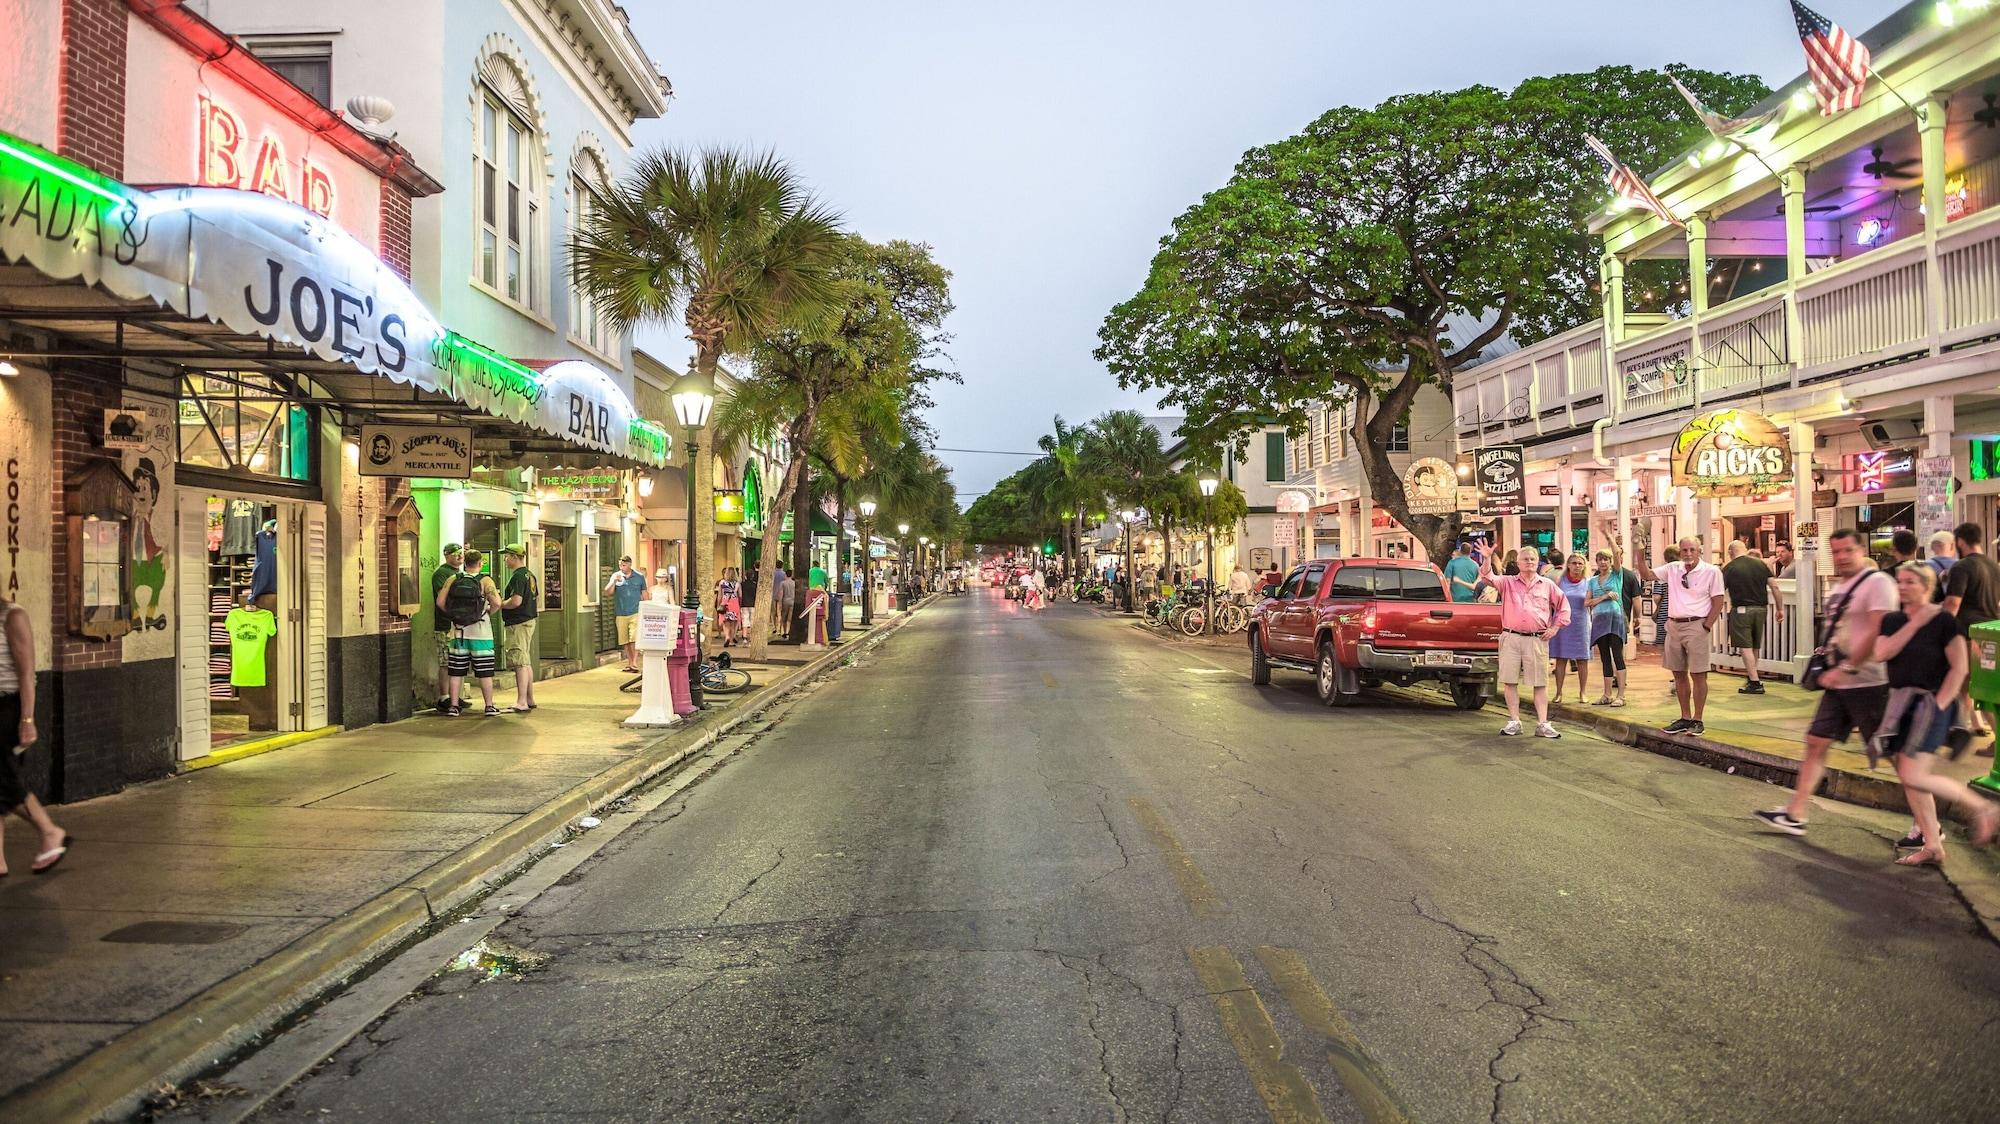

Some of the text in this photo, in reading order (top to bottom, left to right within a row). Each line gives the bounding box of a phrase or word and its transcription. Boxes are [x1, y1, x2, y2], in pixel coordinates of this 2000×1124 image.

[197, 93, 337, 220] BAR
[0, 176, 156, 265] ADA &
[245, 259, 407, 373] JOE'S
[568, 392, 610, 446] BAR
[402, 434, 467, 458] SLOPPY JOE'S
[405, 461, 461, 470] MERCANTILE
[1478, 449, 1521, 471] ANGELINA'S
[1697, 446, 1784, 476] RICK'S
[542, 475, 617, 486] THE LAZY GECKO
[1403, 461, 1421, 499] DURTY
[1426, 457, 1457, 496] HARRY'S
[1483, 477, 1521, 494] PIZZERIA
[1410, 499, 1426, 507] KEY
